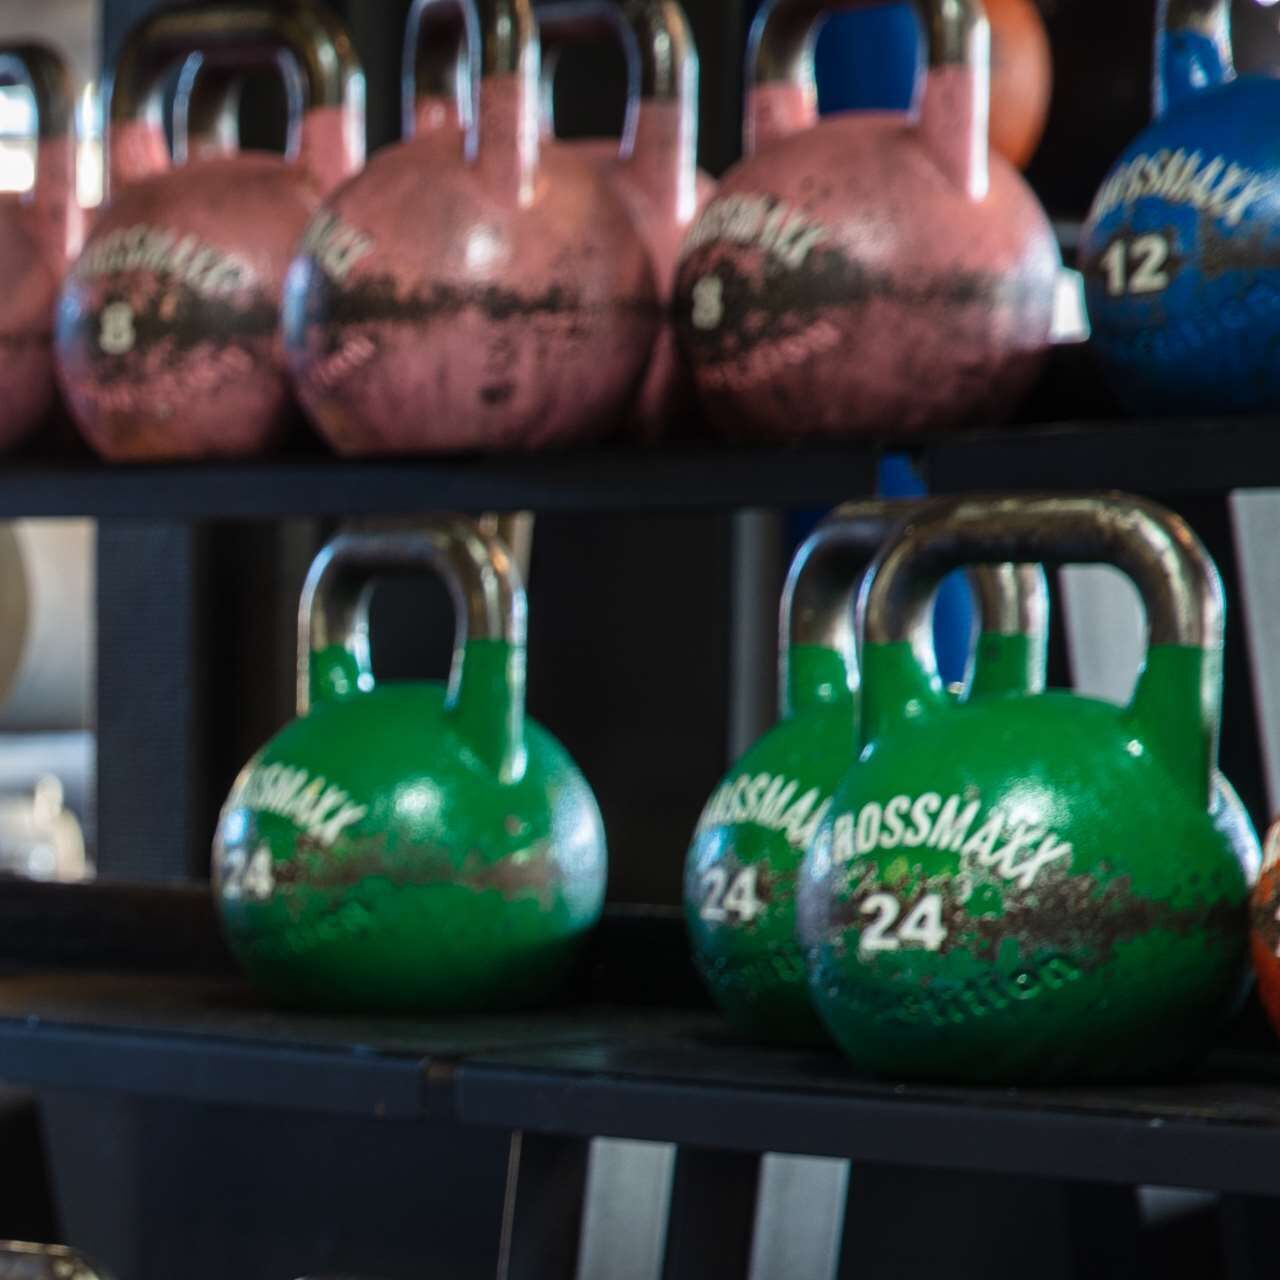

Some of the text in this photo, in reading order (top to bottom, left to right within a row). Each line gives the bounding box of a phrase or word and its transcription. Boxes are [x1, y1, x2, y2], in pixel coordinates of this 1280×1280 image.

[1101, 232, 1169, 295] 12
[222, 844, 275, 900] 24
[699, 865, 761, 921] 24
[859, 892, 947, 952] 24
